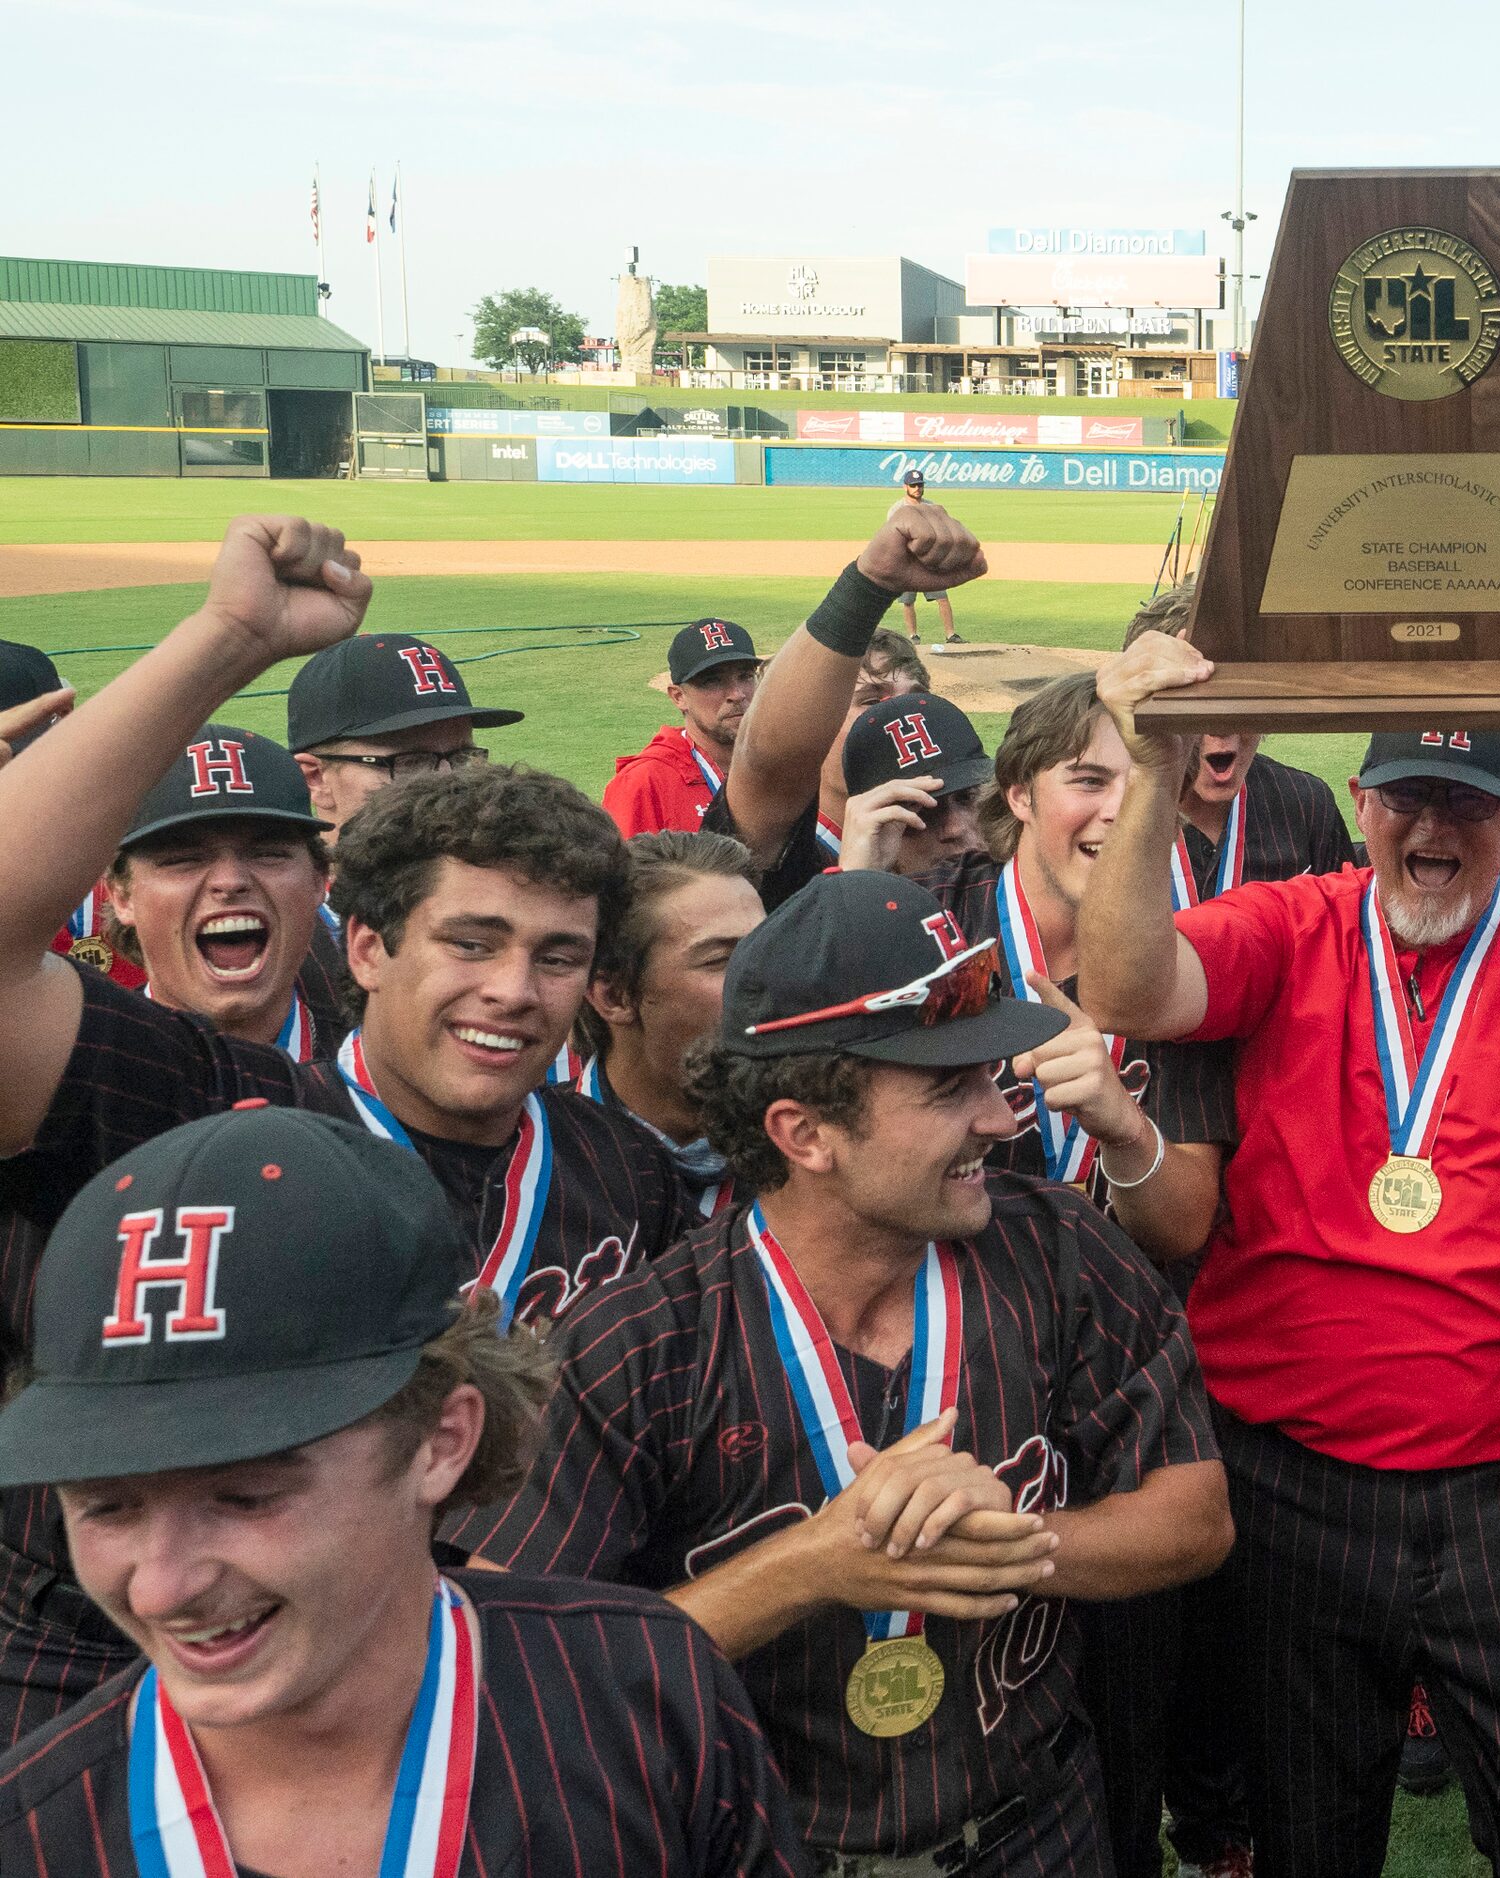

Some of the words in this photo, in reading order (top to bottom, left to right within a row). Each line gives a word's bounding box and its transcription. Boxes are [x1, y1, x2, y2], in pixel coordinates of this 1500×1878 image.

[1014, 229, 1063, 253] Dell
[1069, 229, 1176, 254] Diamond
[1352, 230, 1498, 298] INTERSCHOLASTIC
[740, 303, 780, 315] HOME
[781, 303, 810, 316] RUN
[811, 303, 867, 317] DUGOUT
[1016, 315, 1112, 334] BULLPEN
[1130, 316, 1173, 335] BAR
[1332, 283, 1383, 385] UNIVERSITY
[1382, 342, 1452, 363] STATE
[453, 419, 499, 430] SERIES
[913, 416, 1028, 439] Budweiser
[556, 452, 612, 469] DELL
[612, 453, 717, 474] Technologies
[880, 452, 1015, 484] Welcome
[1020, 453, 1050, 485] to
[1064, 459, 1117, 486] Dell
[1128, 459, 1225, 487] Diamo
[1306, 487, 1371, 551] UNIVERSITY
[1371, 471, 1499, 507] INTERSCHOLASTIC
[1361, 542, 1405, 554] STATE
[1408, 542, 1487, 554] CHAMPION
[1388, 560, 1462, 572] BASEBALL
[1344, 579, 1442, 591] CONFERENCE
[699, 622, 735, 652] H
[1406, 625, 1443, 637] 2021
[398, 646, 457, 695] H
[883, 712, 941, 768] H
[186, 740, 254, 798] H
[1388, 1207, 1418, 1218] STATE
[101, 1205, 235, 1349] H
[874, 1702, 916, 1720] STATE
